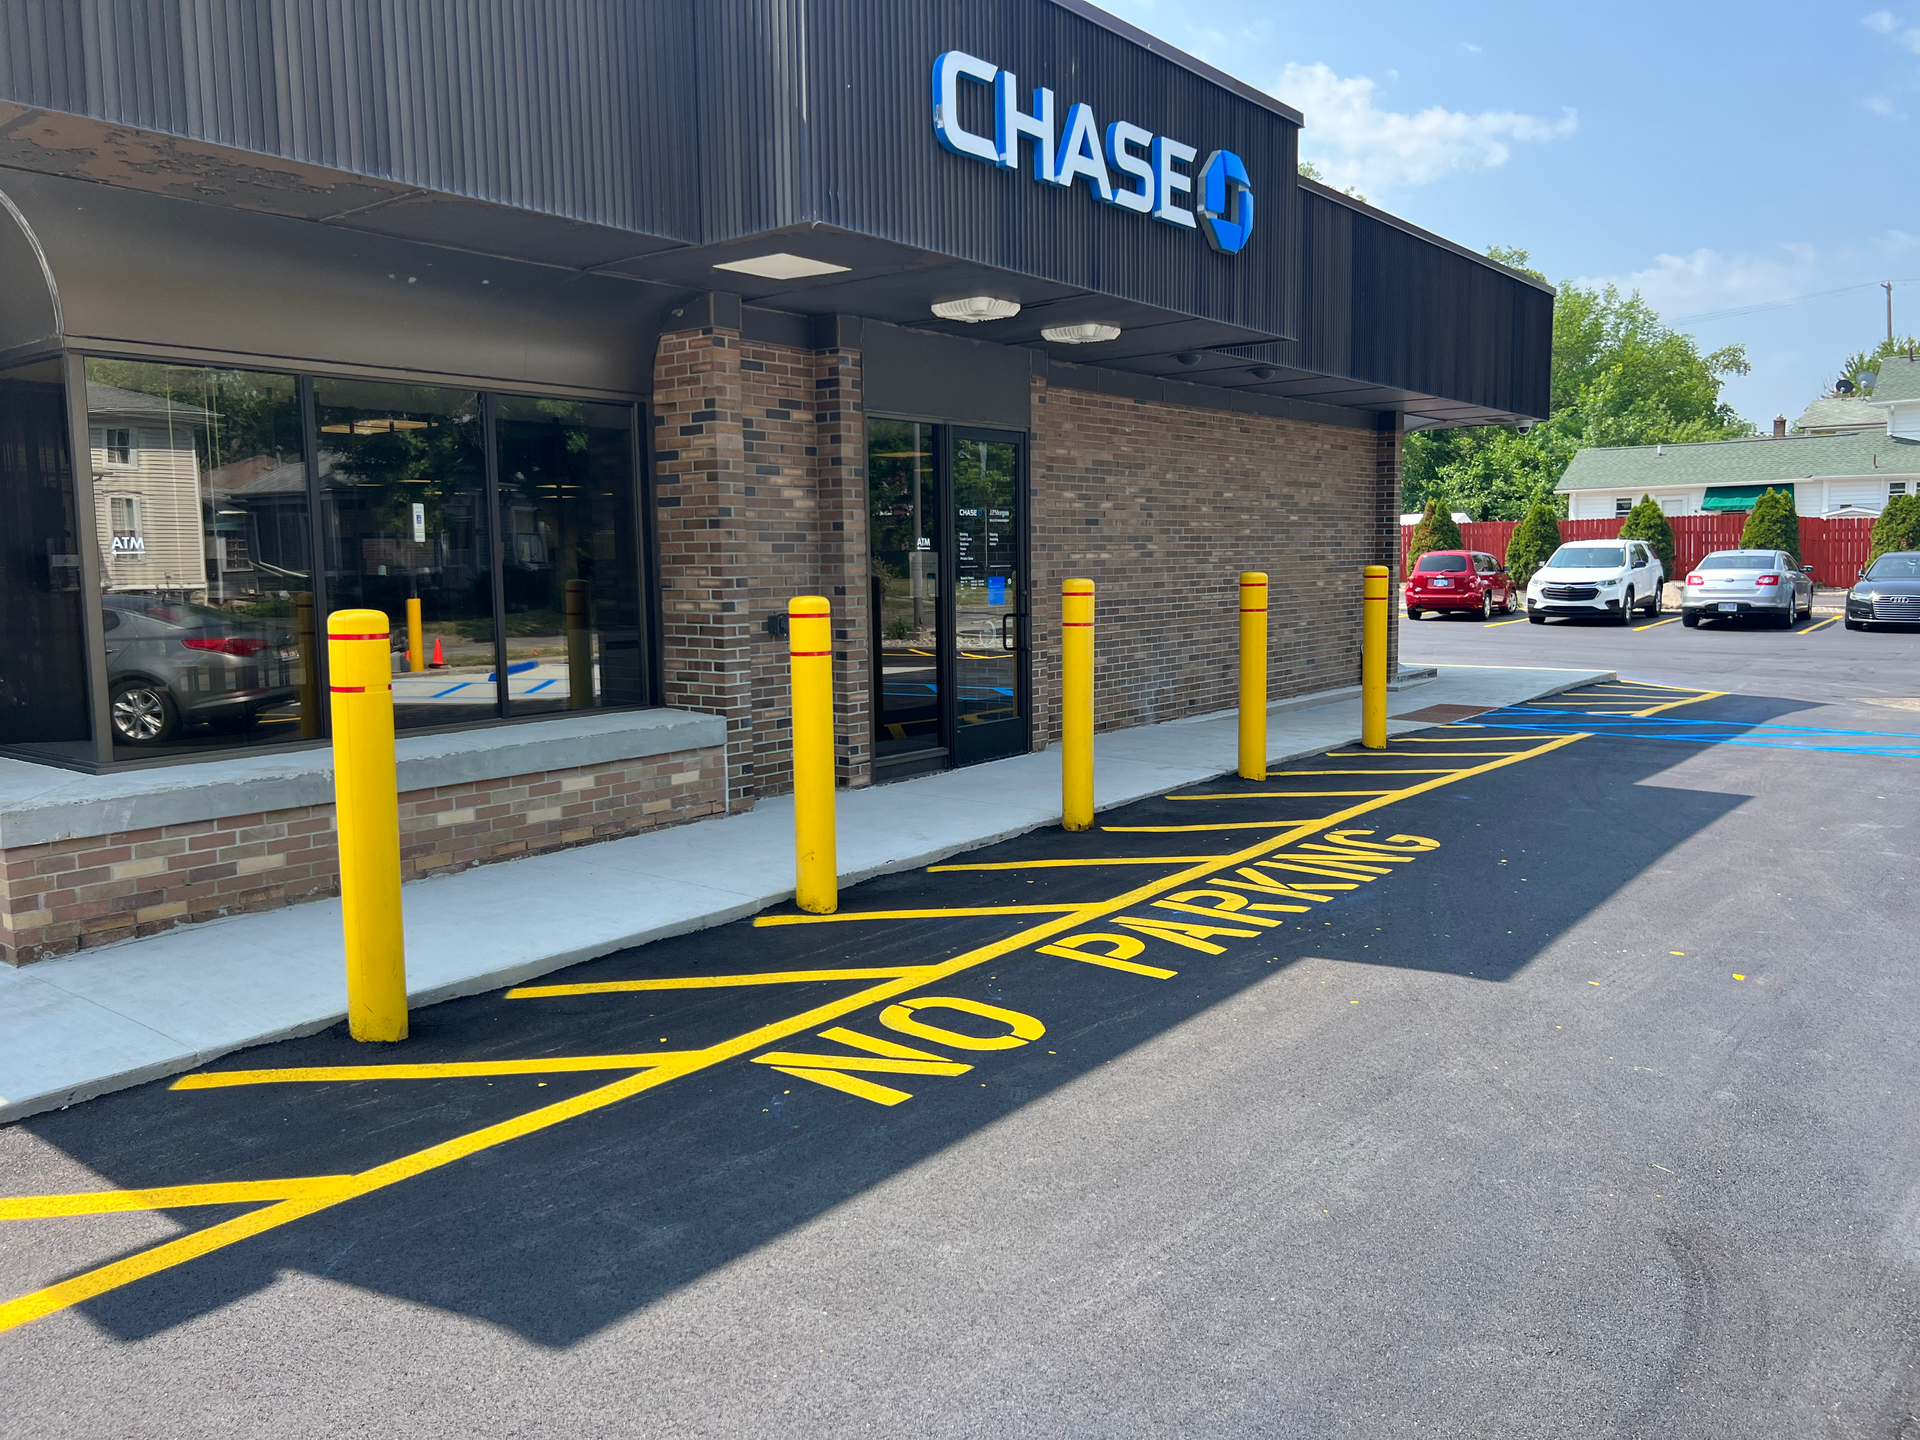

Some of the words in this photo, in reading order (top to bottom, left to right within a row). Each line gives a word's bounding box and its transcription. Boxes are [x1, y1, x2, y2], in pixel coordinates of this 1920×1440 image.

[932, 50, 1198, 230] CHASE
[959, 509, 978, 517] CHASE
[111, 536, 145, 549] ATM
[917, 537, 931, 547] ATM
[750, 996, 1046, 1106] NO
[1035, 829, 1441, 980] PARKING
